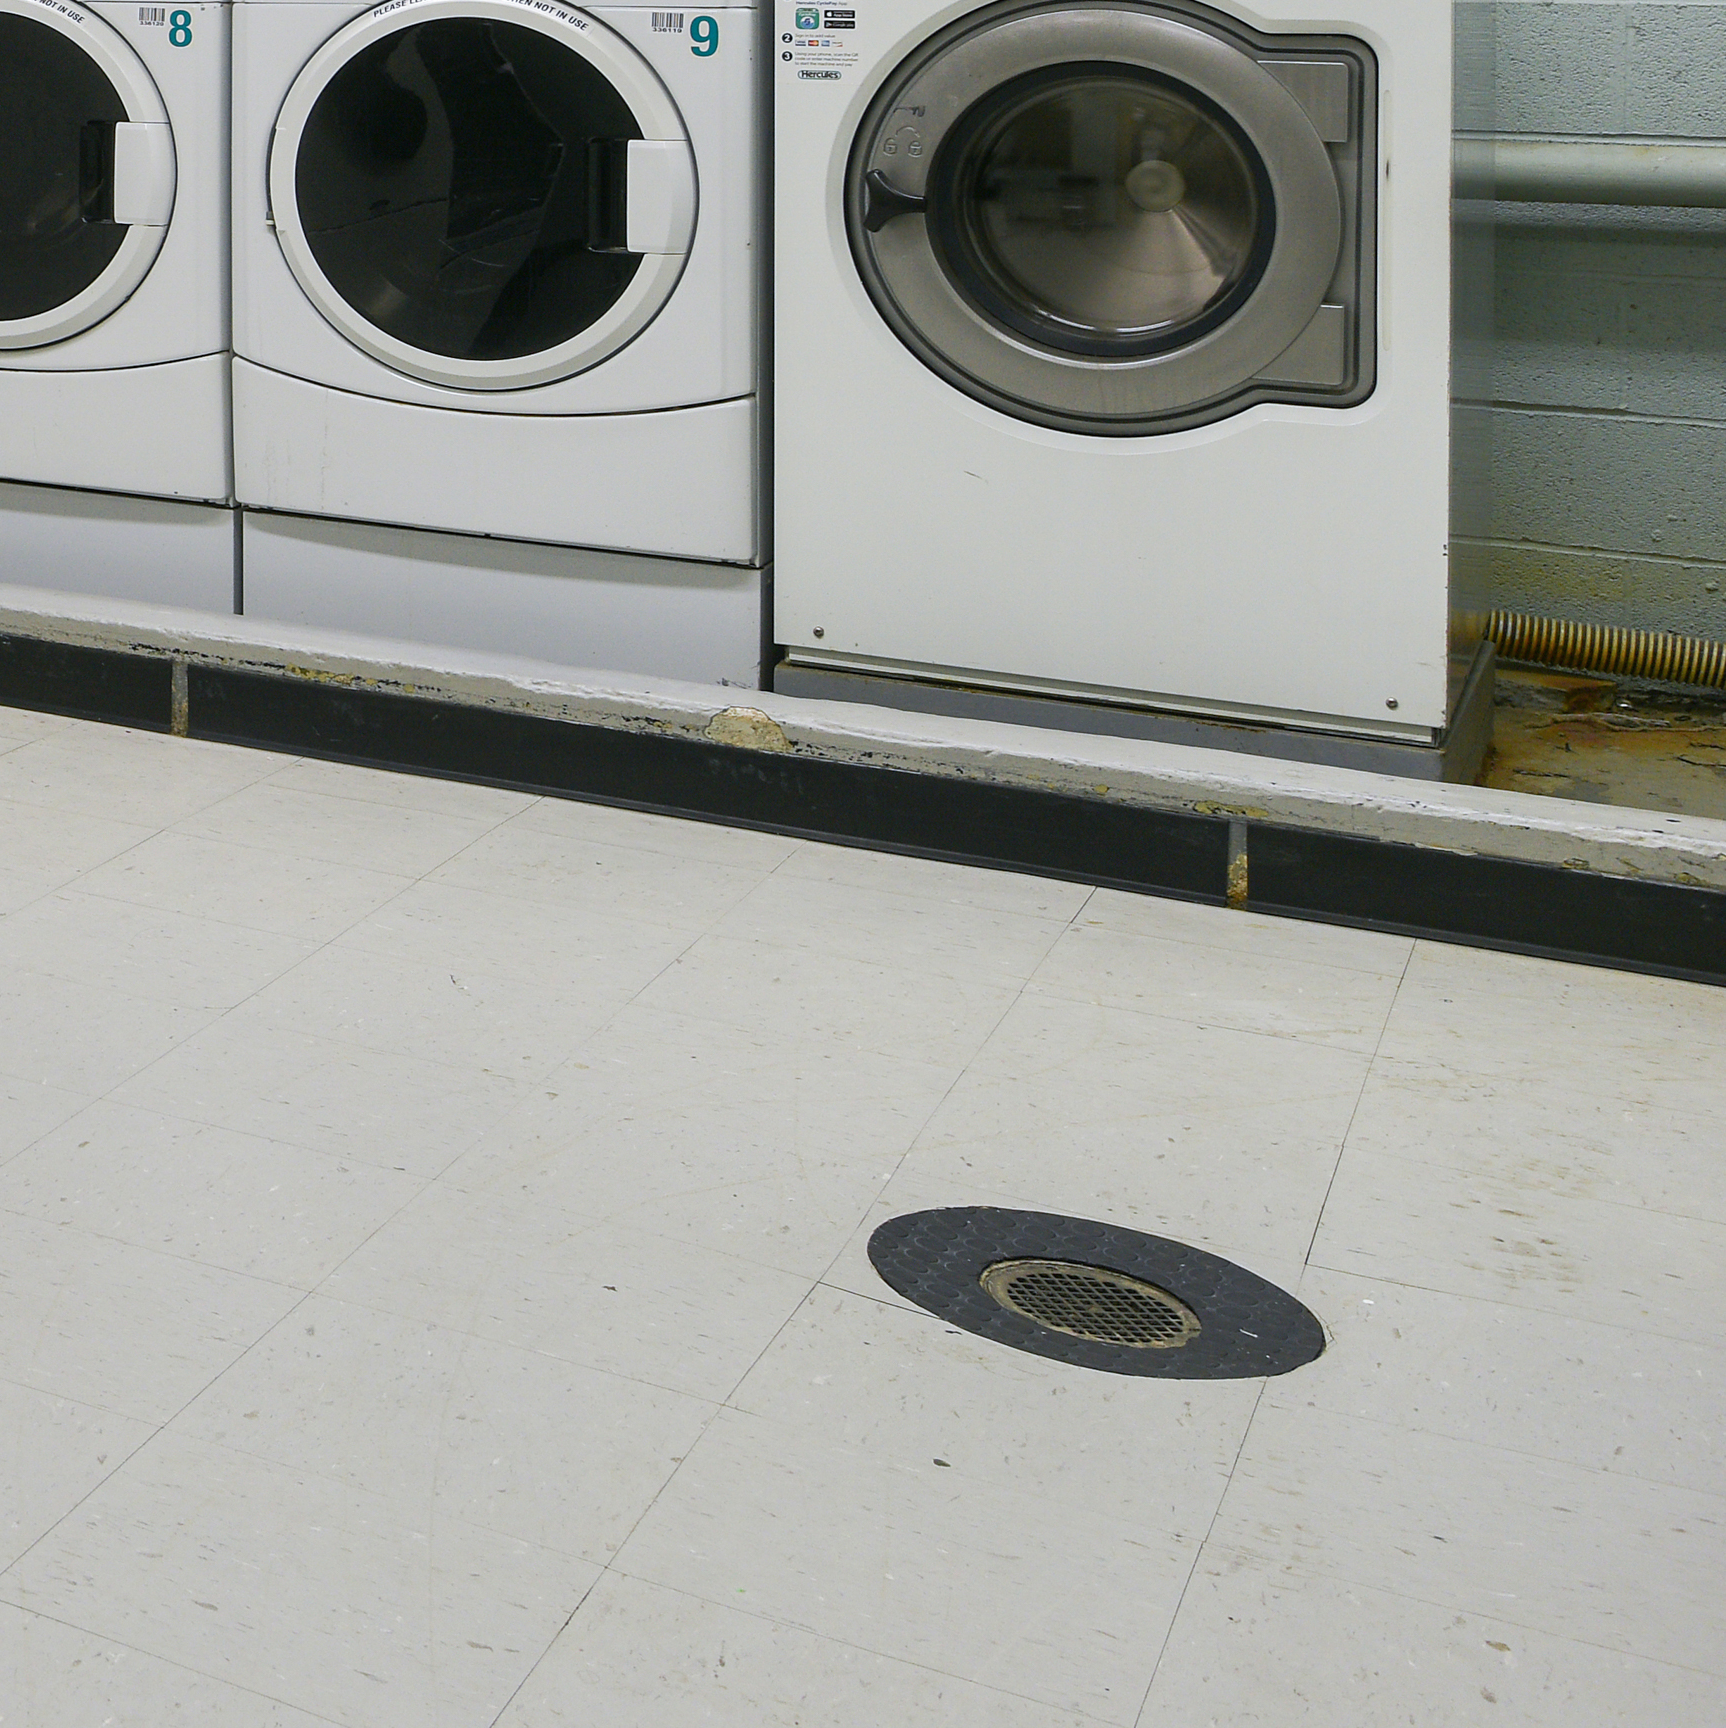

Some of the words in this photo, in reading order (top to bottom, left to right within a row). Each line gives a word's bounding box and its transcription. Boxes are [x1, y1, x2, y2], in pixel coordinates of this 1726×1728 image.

[169, 10, 192, 47] 8
[373, 0, 407, 18] PLEASE
[534, 0, 556, 14] NOT
[556, 8, 569, 20] IN
[567, 15, 589, 32] USE
[689, 14, 719, 58] 9
[801, 70, 839, 79] Hercules
